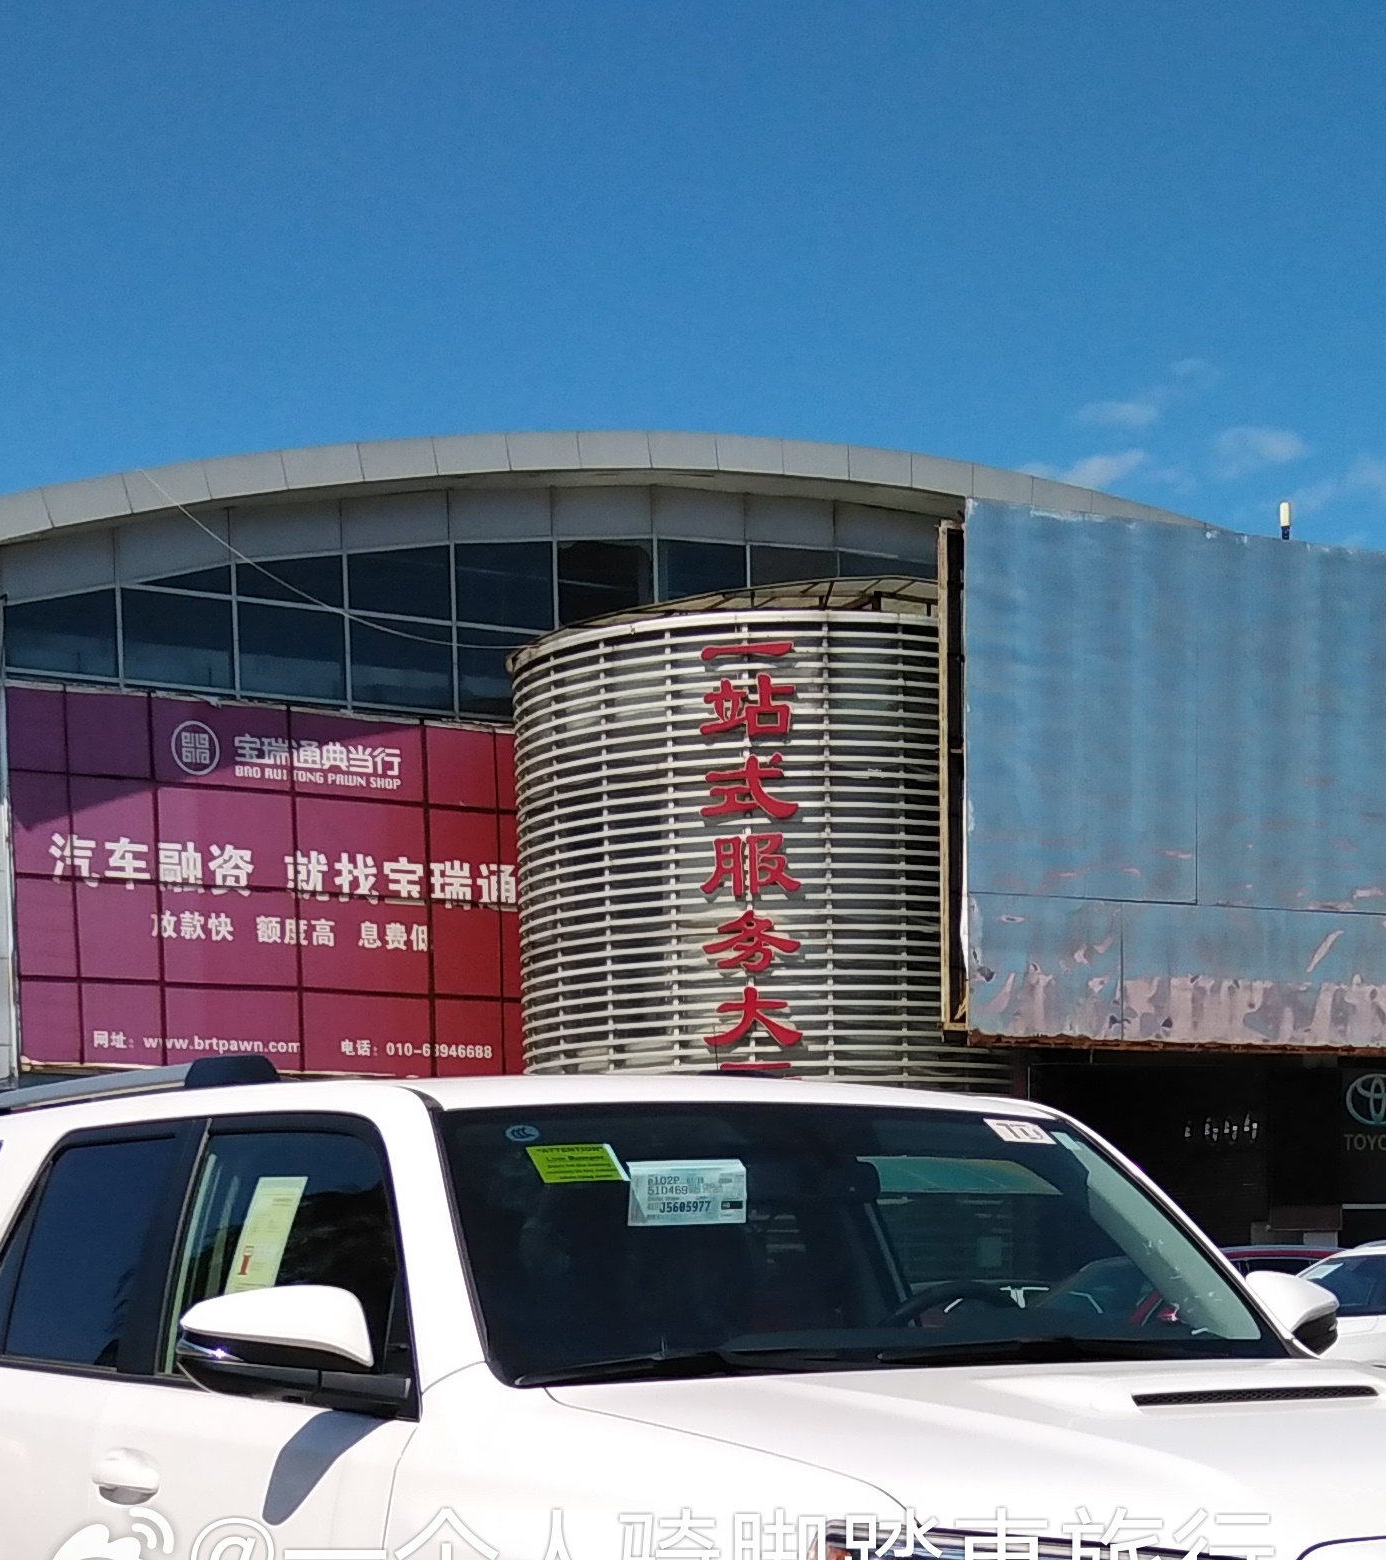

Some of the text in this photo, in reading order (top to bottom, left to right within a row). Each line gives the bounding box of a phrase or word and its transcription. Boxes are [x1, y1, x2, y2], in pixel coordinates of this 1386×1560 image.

[234, 733, 402, 776] 宝瑞通典当行
[235, 766, 261, 779] BAO
[264, 768, 288, 781] RUI
[327, 773, 367, 787] PAWN
[369, 776, 402, 790] SHOP
[49, 833, 519, 912] 汽车融资 就找宝瑞通
[700, 640, 803, 1070] 一站式服务大
[151, 910, 430, 951] 放款快 额度高 息费低
[143, 1035, 301, 1055] www.brtpawn.com
